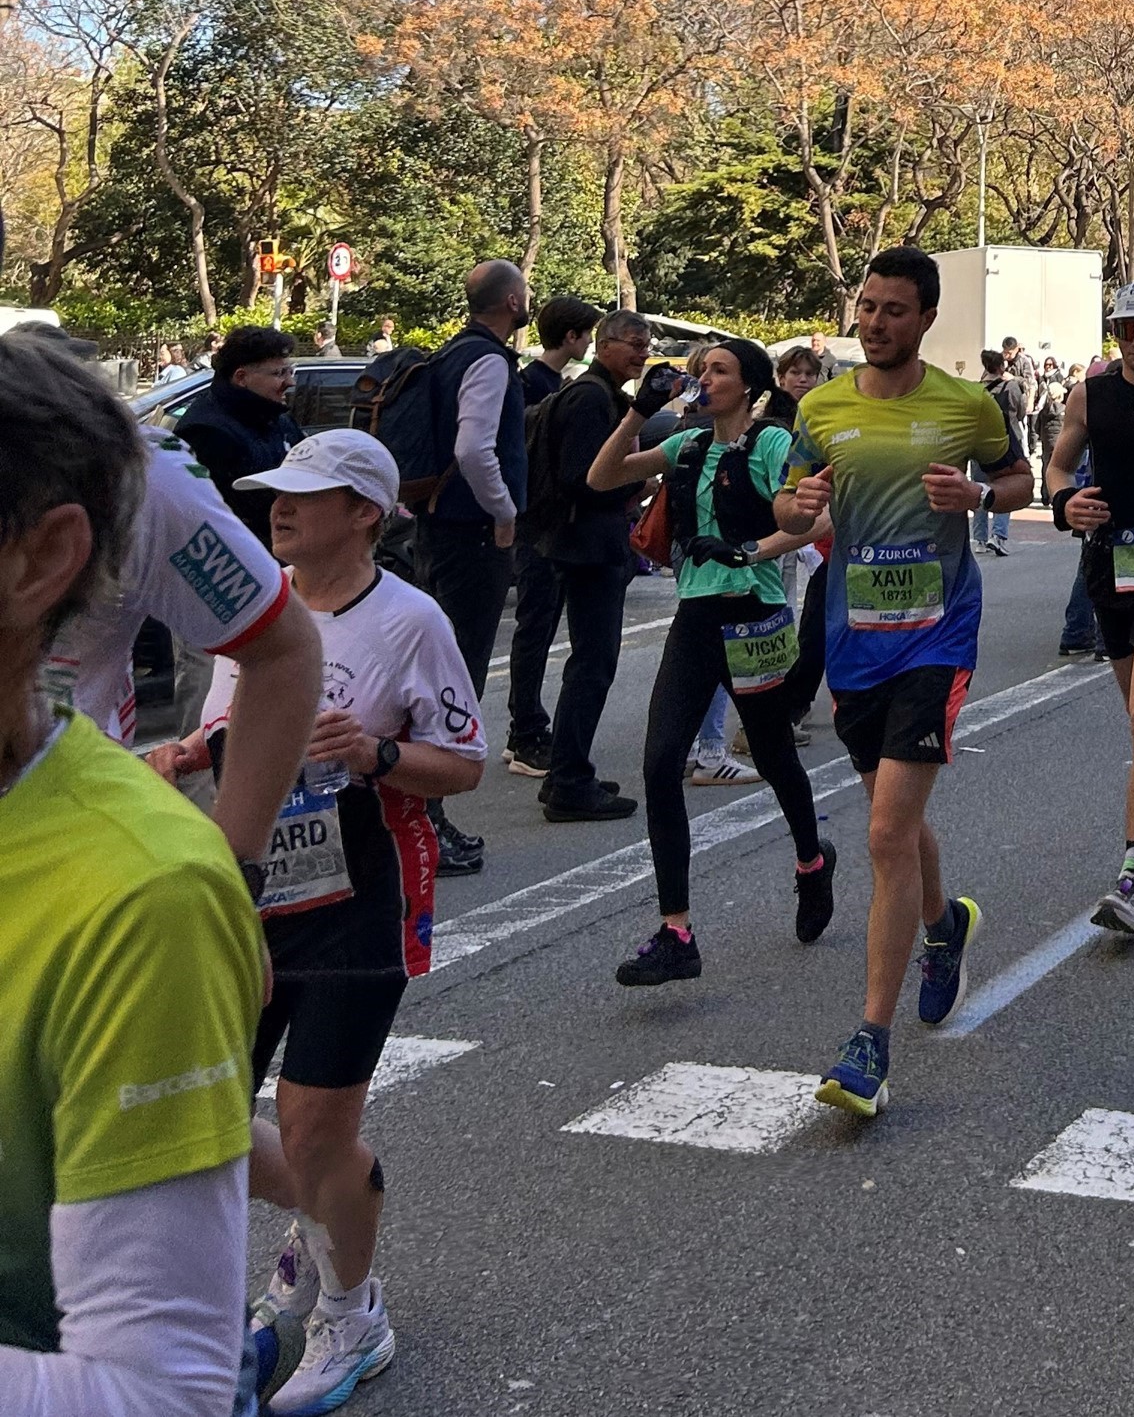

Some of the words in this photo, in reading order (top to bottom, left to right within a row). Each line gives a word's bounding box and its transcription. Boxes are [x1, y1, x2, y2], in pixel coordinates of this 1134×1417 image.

[831, 428, 861, 445] HOKA
[878, 548, 921, 560] ZURICH
[187, 528, 257, 610] SWM
[871, 568, 913, 587] XAVI
[881, 589, 912, 601] 18731
[753, 612, 789, 633] ZURICH
[879, 612, 906, 621] HOKA
[745, 633, 787, 657] VICKY
[759, 653, 787, 668] 25240
